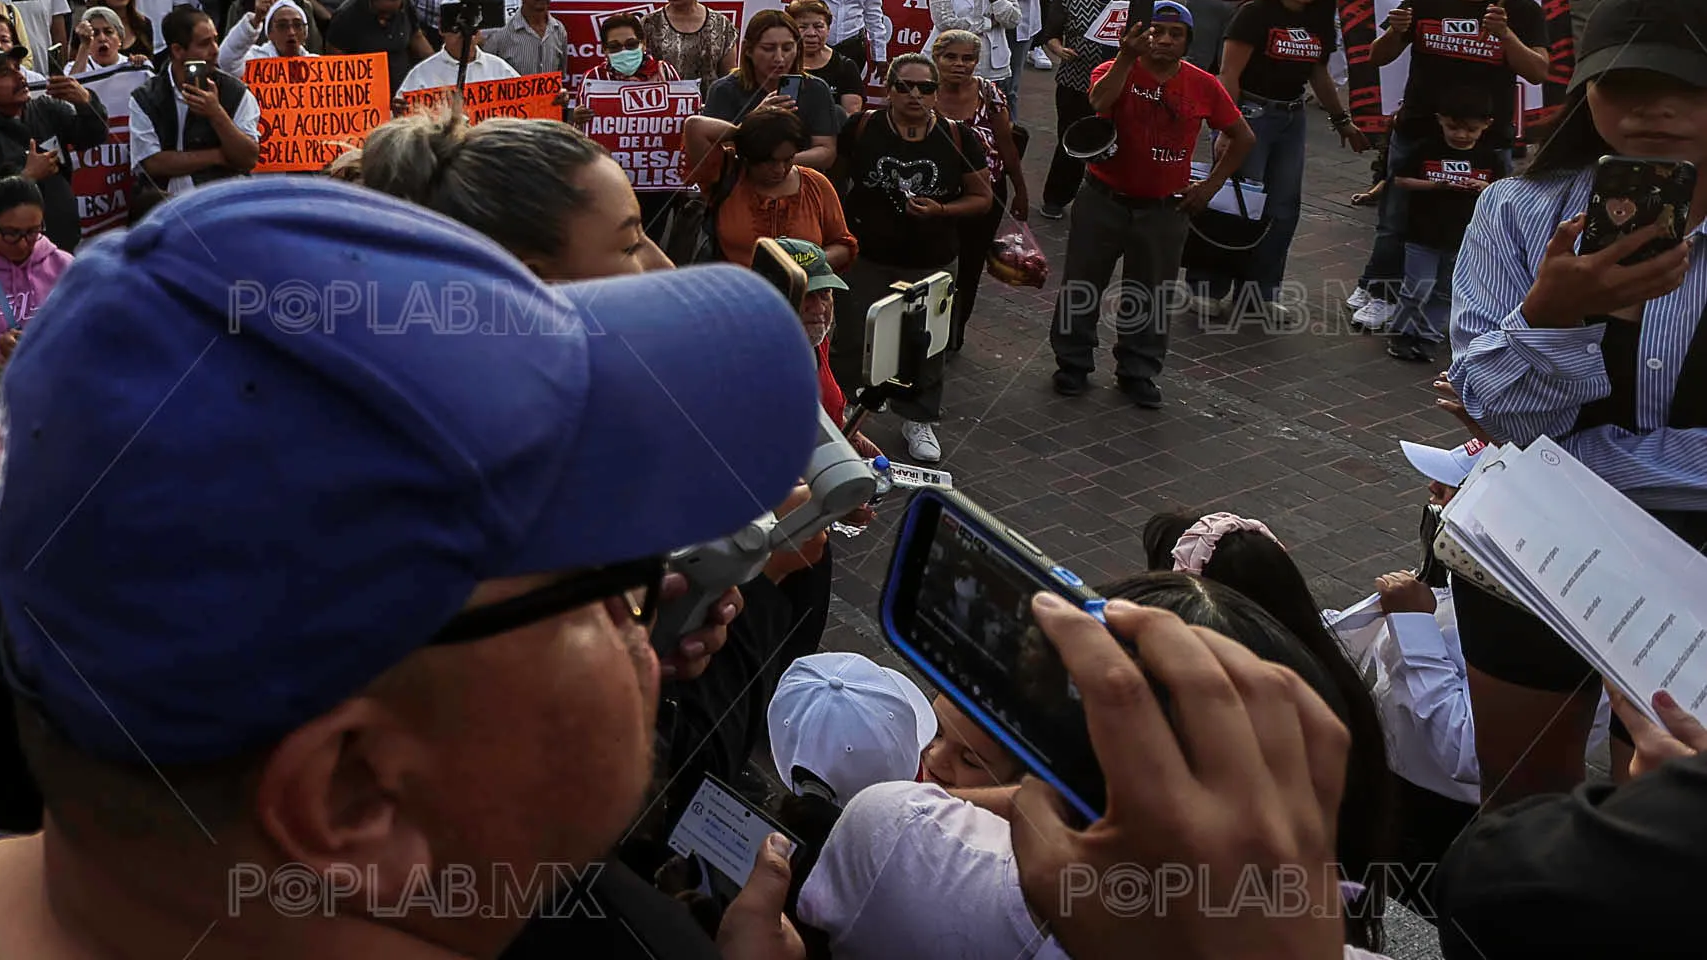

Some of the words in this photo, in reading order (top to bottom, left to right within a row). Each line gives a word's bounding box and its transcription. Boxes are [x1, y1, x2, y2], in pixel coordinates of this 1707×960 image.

[1446, 19, 1478, 35] NO
[1425, 42, 1459, 54] PRESA
[254, 61, 287, 84] AGUA
[310, 61, 323, 83] SE
[326, 59, 373, 82] VENDE
[290, 85, 304, 109] SE
[310, 83, 371, 109] DEFIENDE
[478, 83, 494, 104] DE
[497, 75, 562, 101] NUESTROS
[624, 86, 667, 114] NO
[271, 114, 288, 137] AL
[293, 108, 381, 137] ACUEDUCTO
[268, 142, 283, 163] DE
[285, 141, 303, 163] LA
[618, 136, 638, 148] DE
[642, 136, 664, 148] LA
[1444, 161, 1470, 174] NO
